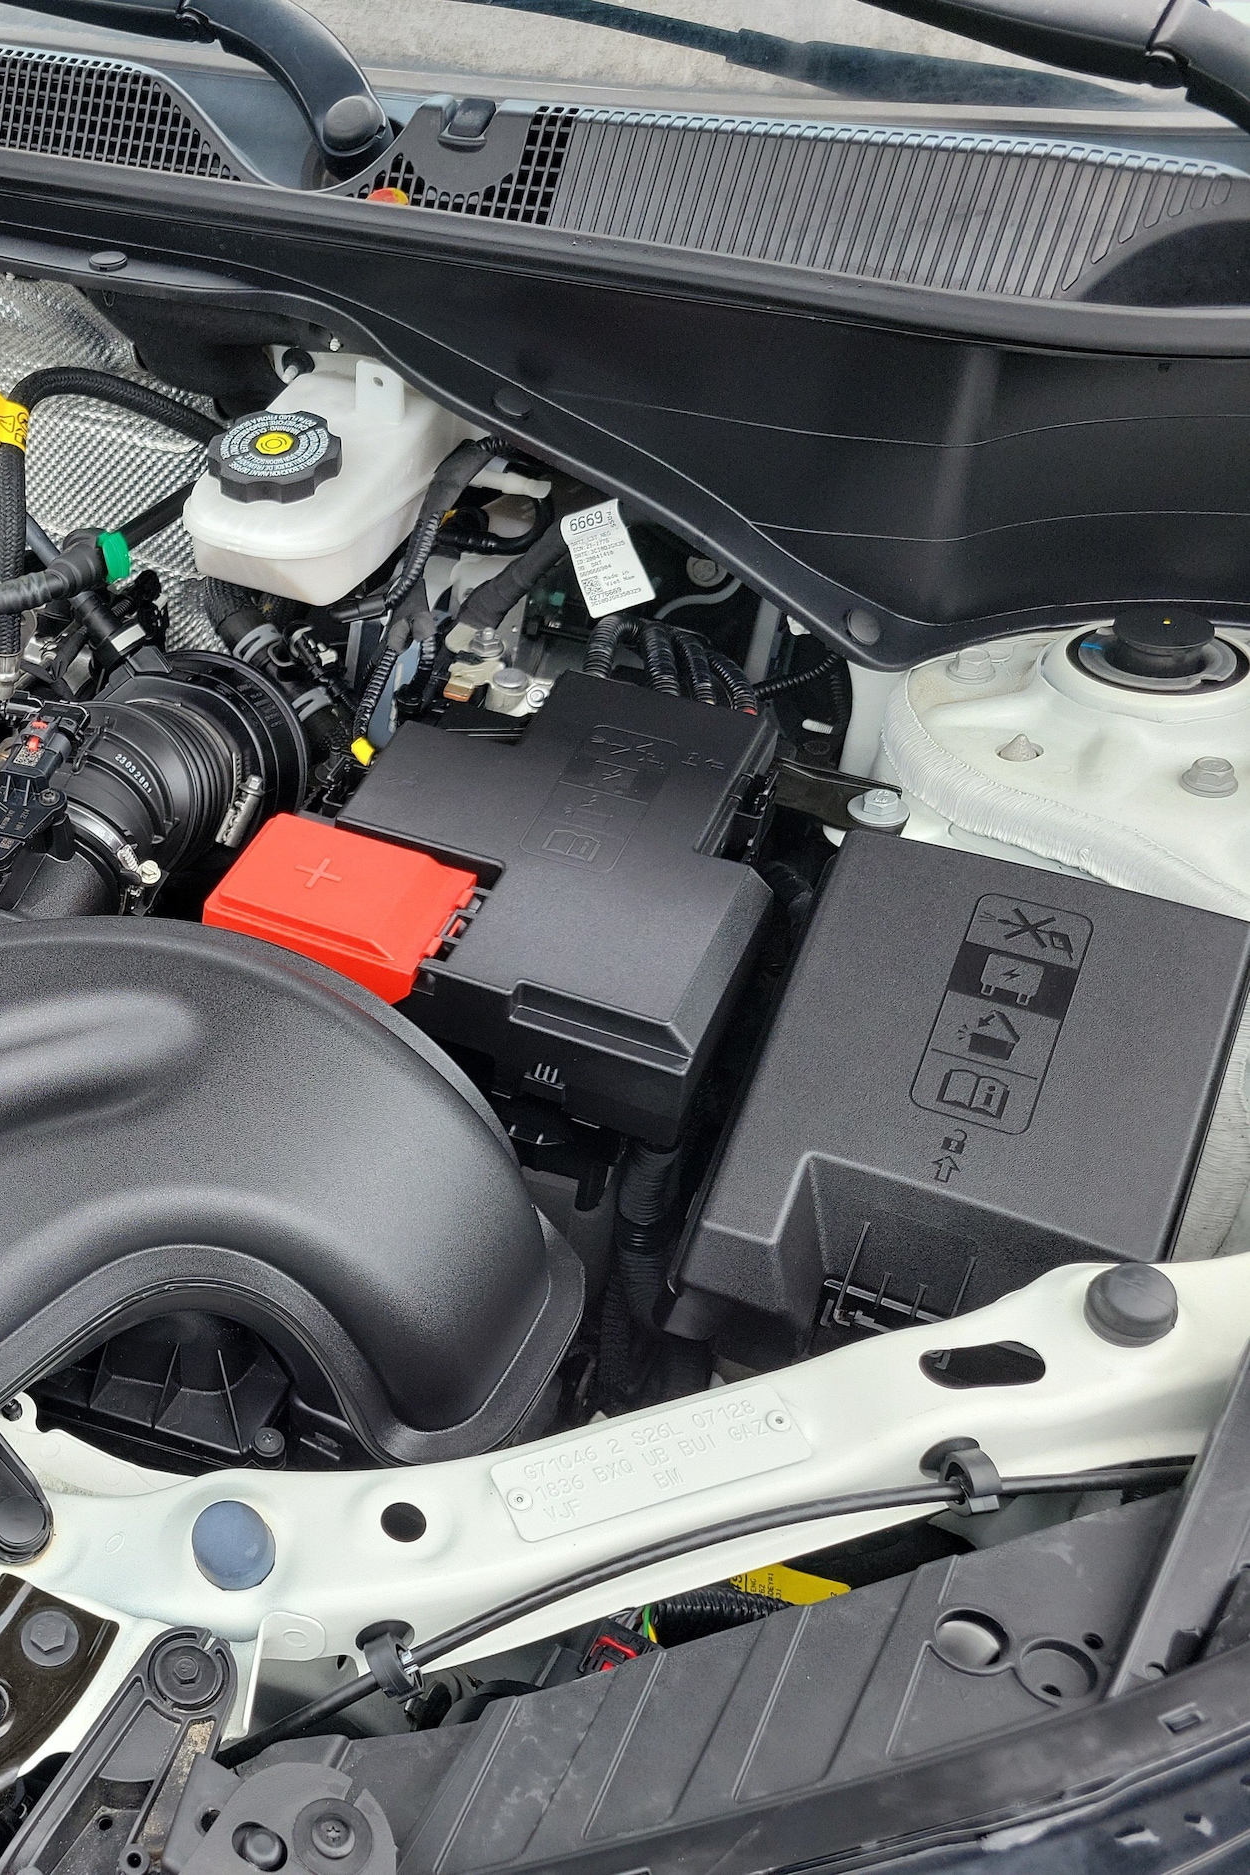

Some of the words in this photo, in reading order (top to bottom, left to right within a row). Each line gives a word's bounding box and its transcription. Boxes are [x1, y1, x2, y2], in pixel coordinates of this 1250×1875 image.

[255, 414, 277, 423] FROM
[570, 511, 602, 531] 6669
[524, 1446, 598, 1480] G71046
[607, 1438, 623, 1454] 2
[632, 1423, 683, 1446] S26L
[692, 1400, 756, 1428] 07128
[536, 1474, 584, 1500] 1836
[593, 1458, 634, 1484] BXQ
[642, 1448, 668, 1467] UB
[728, 1418, 768, 1441] GAZ
[653, 1468, 684, 1490] BM
[544, 1499, 581, 1522] VJF
